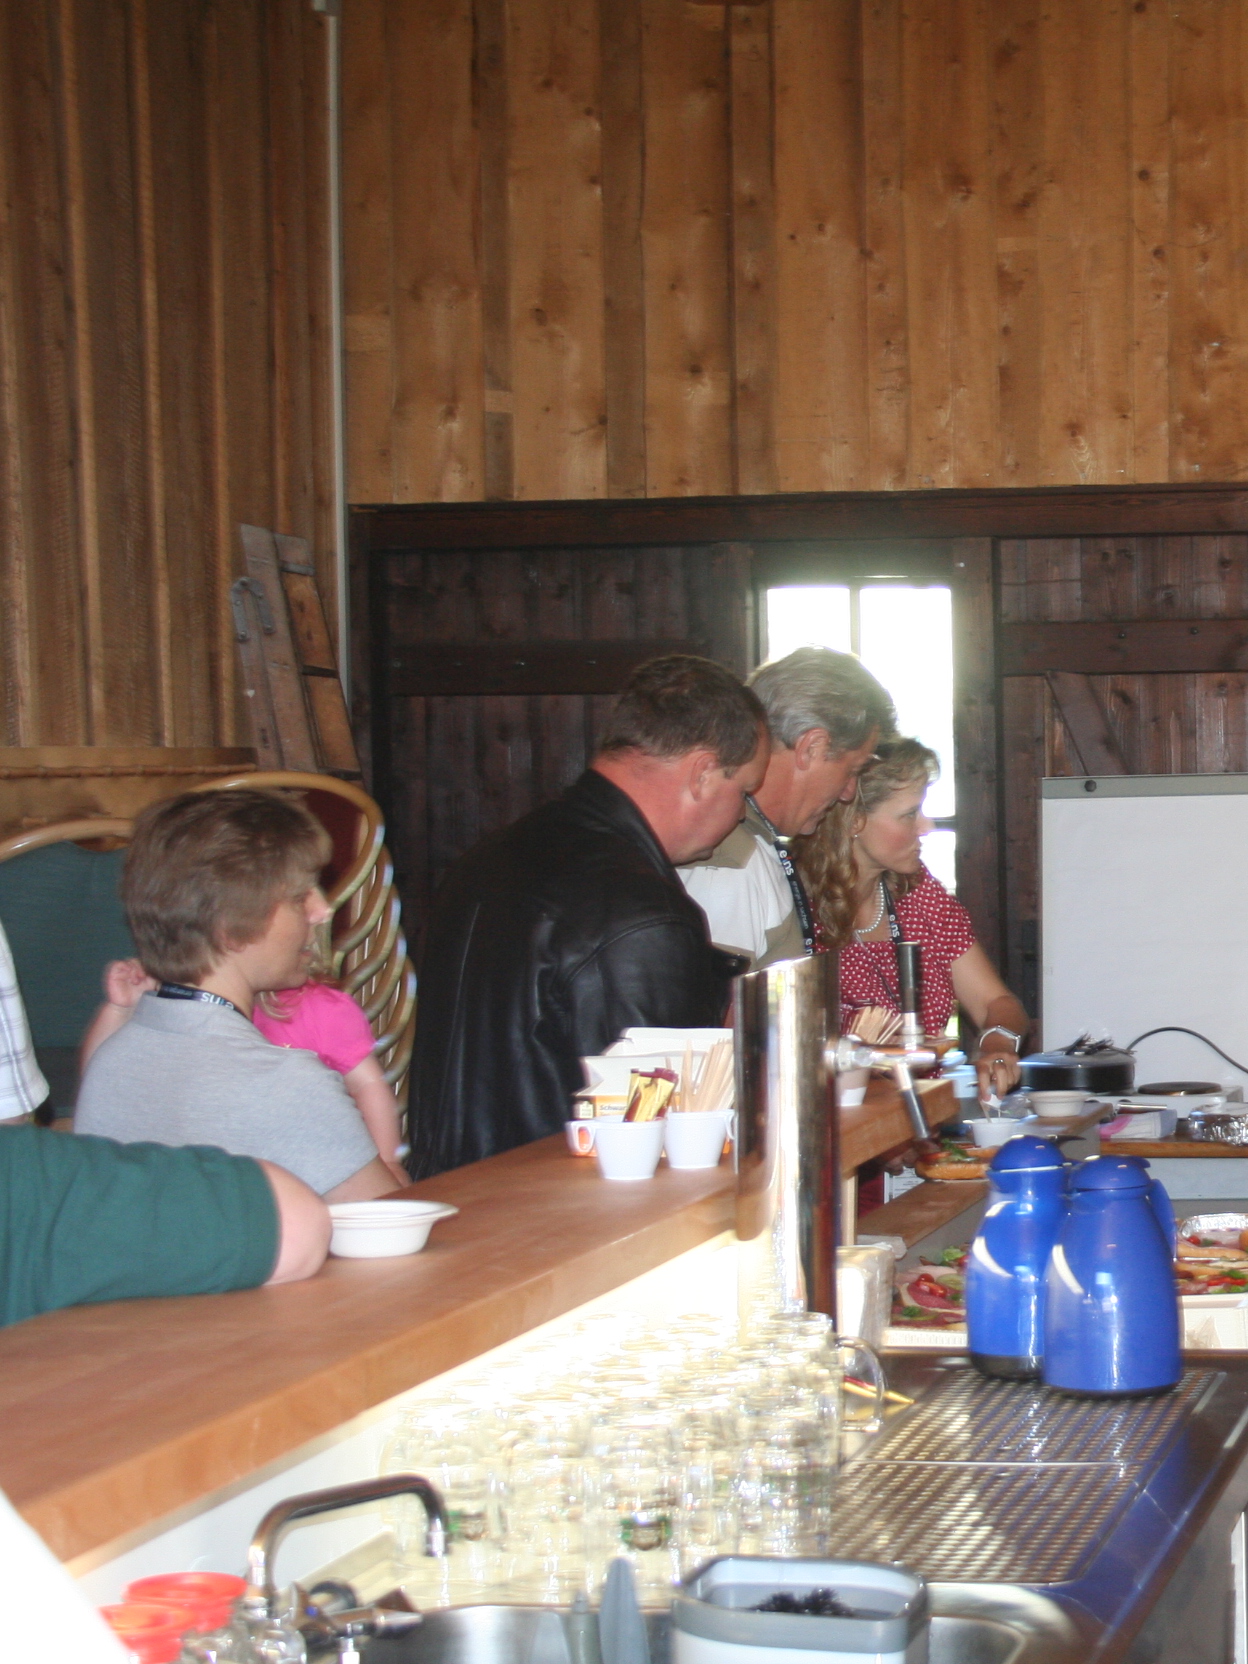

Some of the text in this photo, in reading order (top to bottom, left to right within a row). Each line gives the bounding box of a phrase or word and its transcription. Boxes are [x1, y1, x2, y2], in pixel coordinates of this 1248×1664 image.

[780, 849, 795, 876] eins
[889, 914, 901, 938] eins
[804, 938, 814, 956] ein
